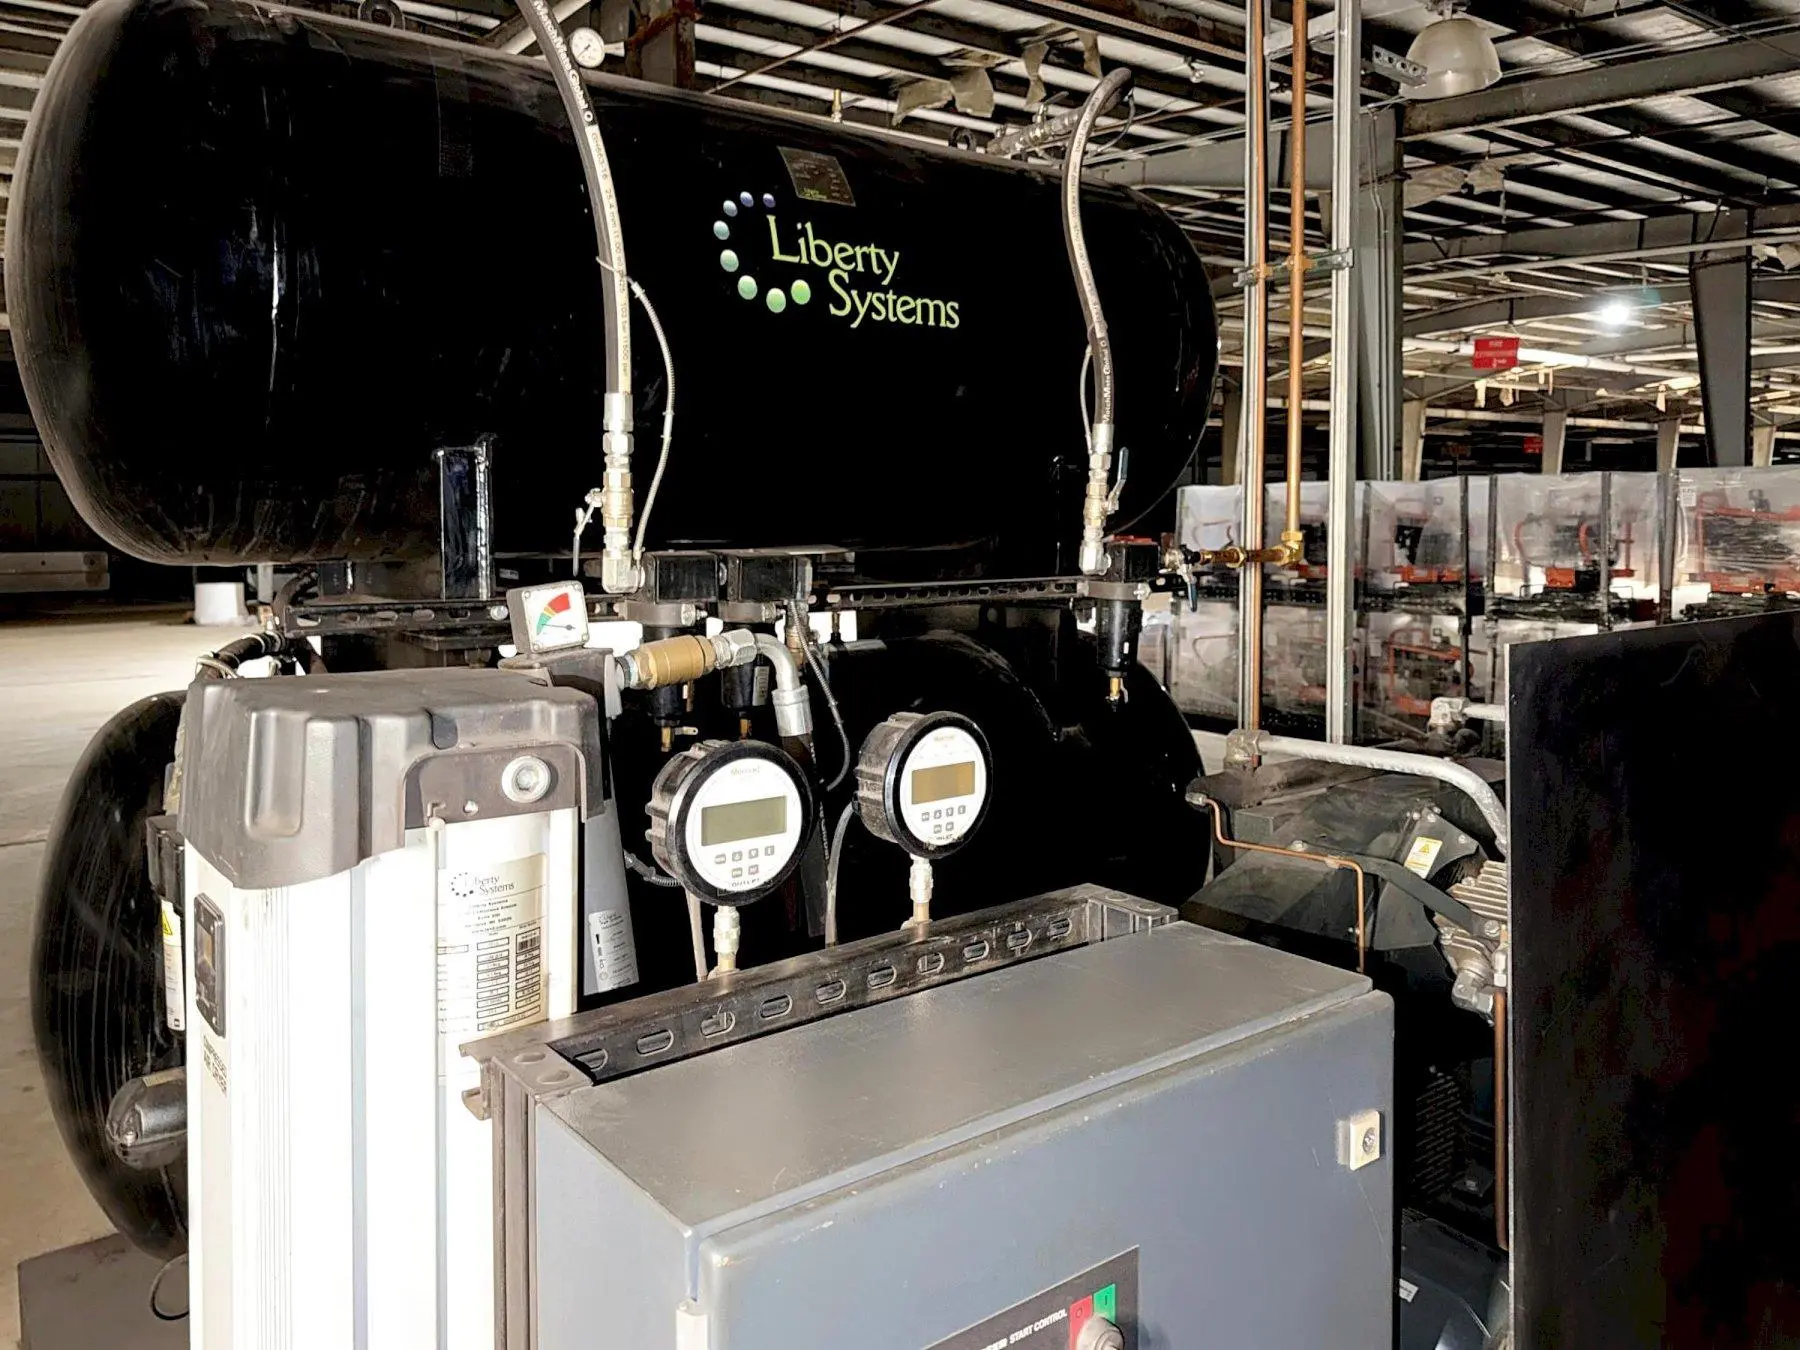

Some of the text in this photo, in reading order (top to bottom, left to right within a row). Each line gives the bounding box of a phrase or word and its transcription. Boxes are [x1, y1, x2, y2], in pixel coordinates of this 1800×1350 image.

[569, 69, 588, 110] Global
[766, 214, 900, 285] Liberty
[828, 268, 960, 328] Systems
[1009, 1324, 1034, 1344] START
[1033, 1308, 1068, 1333] CONTROL
